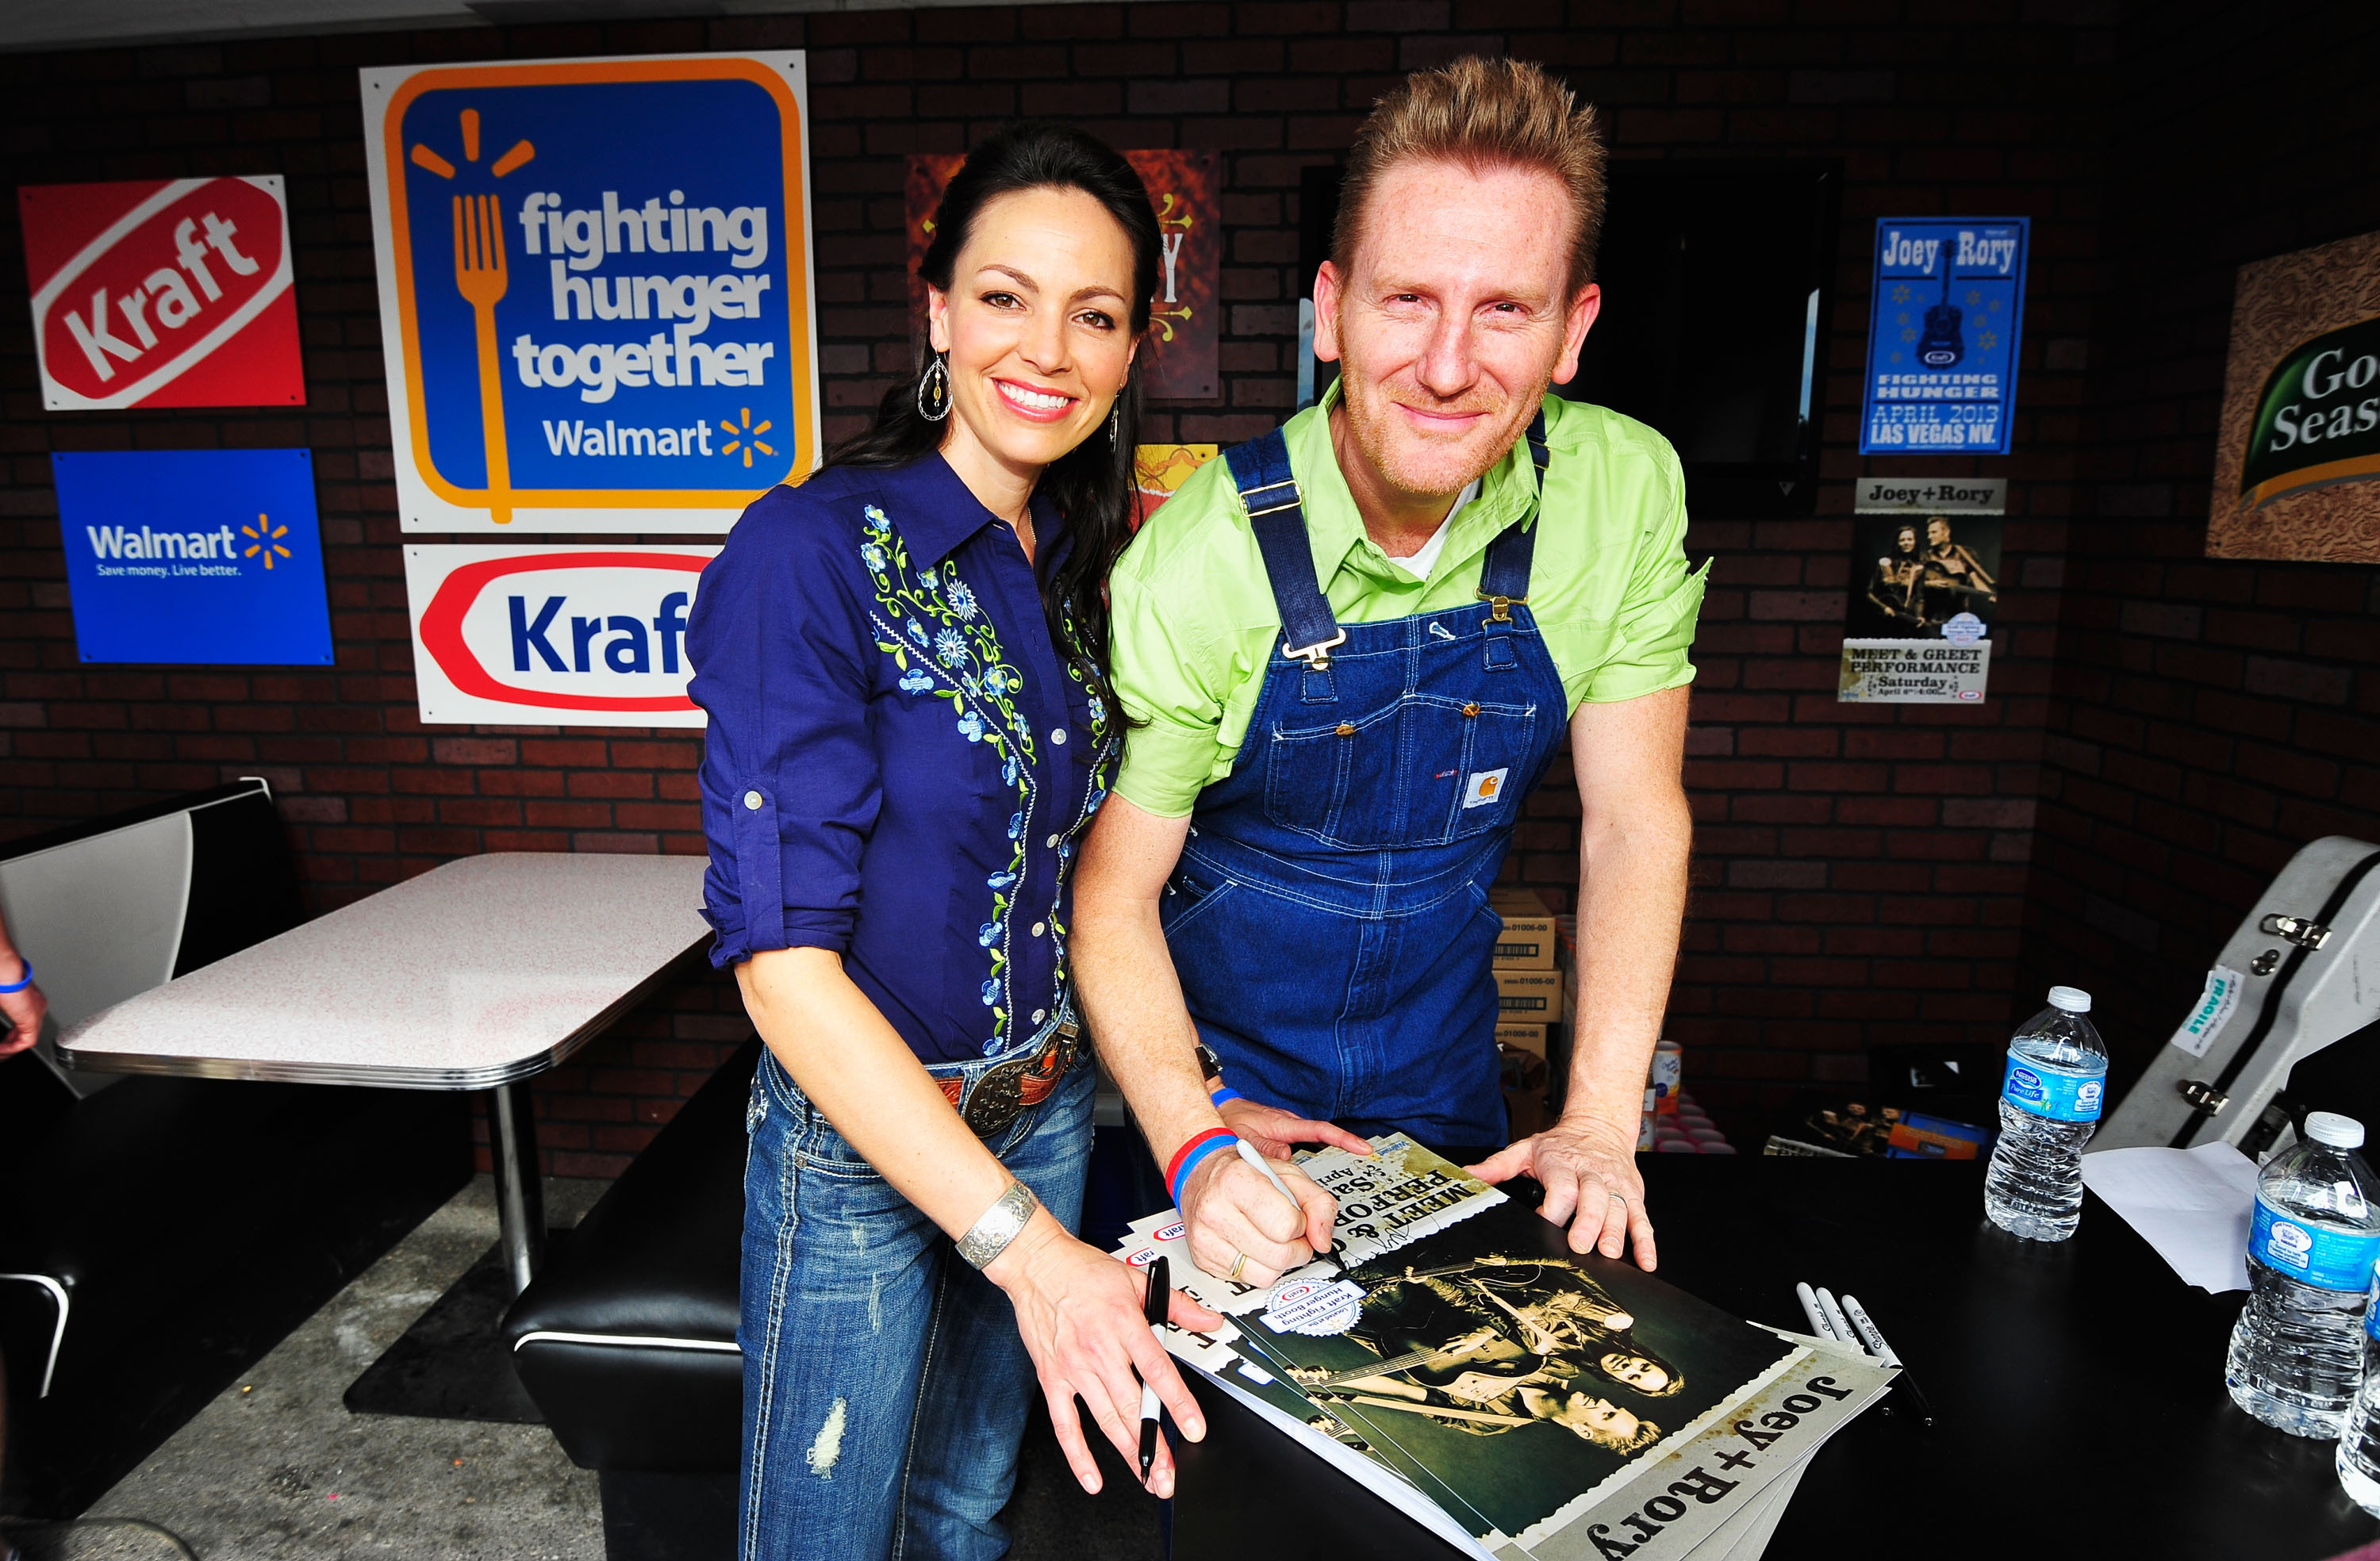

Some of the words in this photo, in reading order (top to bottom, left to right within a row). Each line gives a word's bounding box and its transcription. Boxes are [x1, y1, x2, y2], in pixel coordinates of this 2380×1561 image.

[518, 190, 768, 271] fighting
[1883, 231, 1940, 274] Joey
[1956, 231, 2017, 274] Rory
[63, 211, 260, 383] Kraft
[550, 259, 770, 336] hunger
[512, 323, 774, 405] together
[2302, 348, 2380, 399] Go
[1877, 374, 1998, 385] FIGHTING
[1876, 386, 1999, 398] HUNGER
[1871, 405, 1940, 424] APRIL
[1948, 405, 1999, 424] 2013
[1870, 424, 1904, 444] LAS
[1907, 424, 1965, 444] VEGAS
[1968, 424, 1996, 444] NV.
[2269, 397, 2380, 453] Seas
[542, 419, 712, 457] Walmart
[86, 525, 237, 559] Walmart
[96, 564, 125, 576] Save
[126, 566, 171, 579] money.
[171, 564, 198, 576] Live
[199, 564, 242, 576] better.
[508, 591, 689, 674] Kraf
[1851, 648, 1901, 660] MEET
[1905, 649, 1917, 660] &
[1922, 648, 1982, 661] GREET
[1850, 662, 1980, 673] PERFORMANCE
[1878, 676, 1947, 689] Saturday
[2188, 978, 2226, 1034] FRAGILE
[2010, 1083, 2024, 1095] Pure
[2025, 1089, 2040, 1099] Life
[1377, 1141, 1408, 1156] Walmart
[1381, 1183, 1476, 1229] MEET
[1162, 1225, 1184, 1237] raft
[1347, 1223, 1380, 1238] &
[1134, 1250, 1154, 1262] raft
[1287, 1288, 1304, 1299] Kraft
[1306, 1287, 1343, 1306] Hunger
[1326, 1292, 1353, 1306] Kraft
[1273, 1304, 1306, 1320] Booth
[1281, 1305, 1326, 1326] Fighting
[1324, 1307, 1349, 1321] Located
